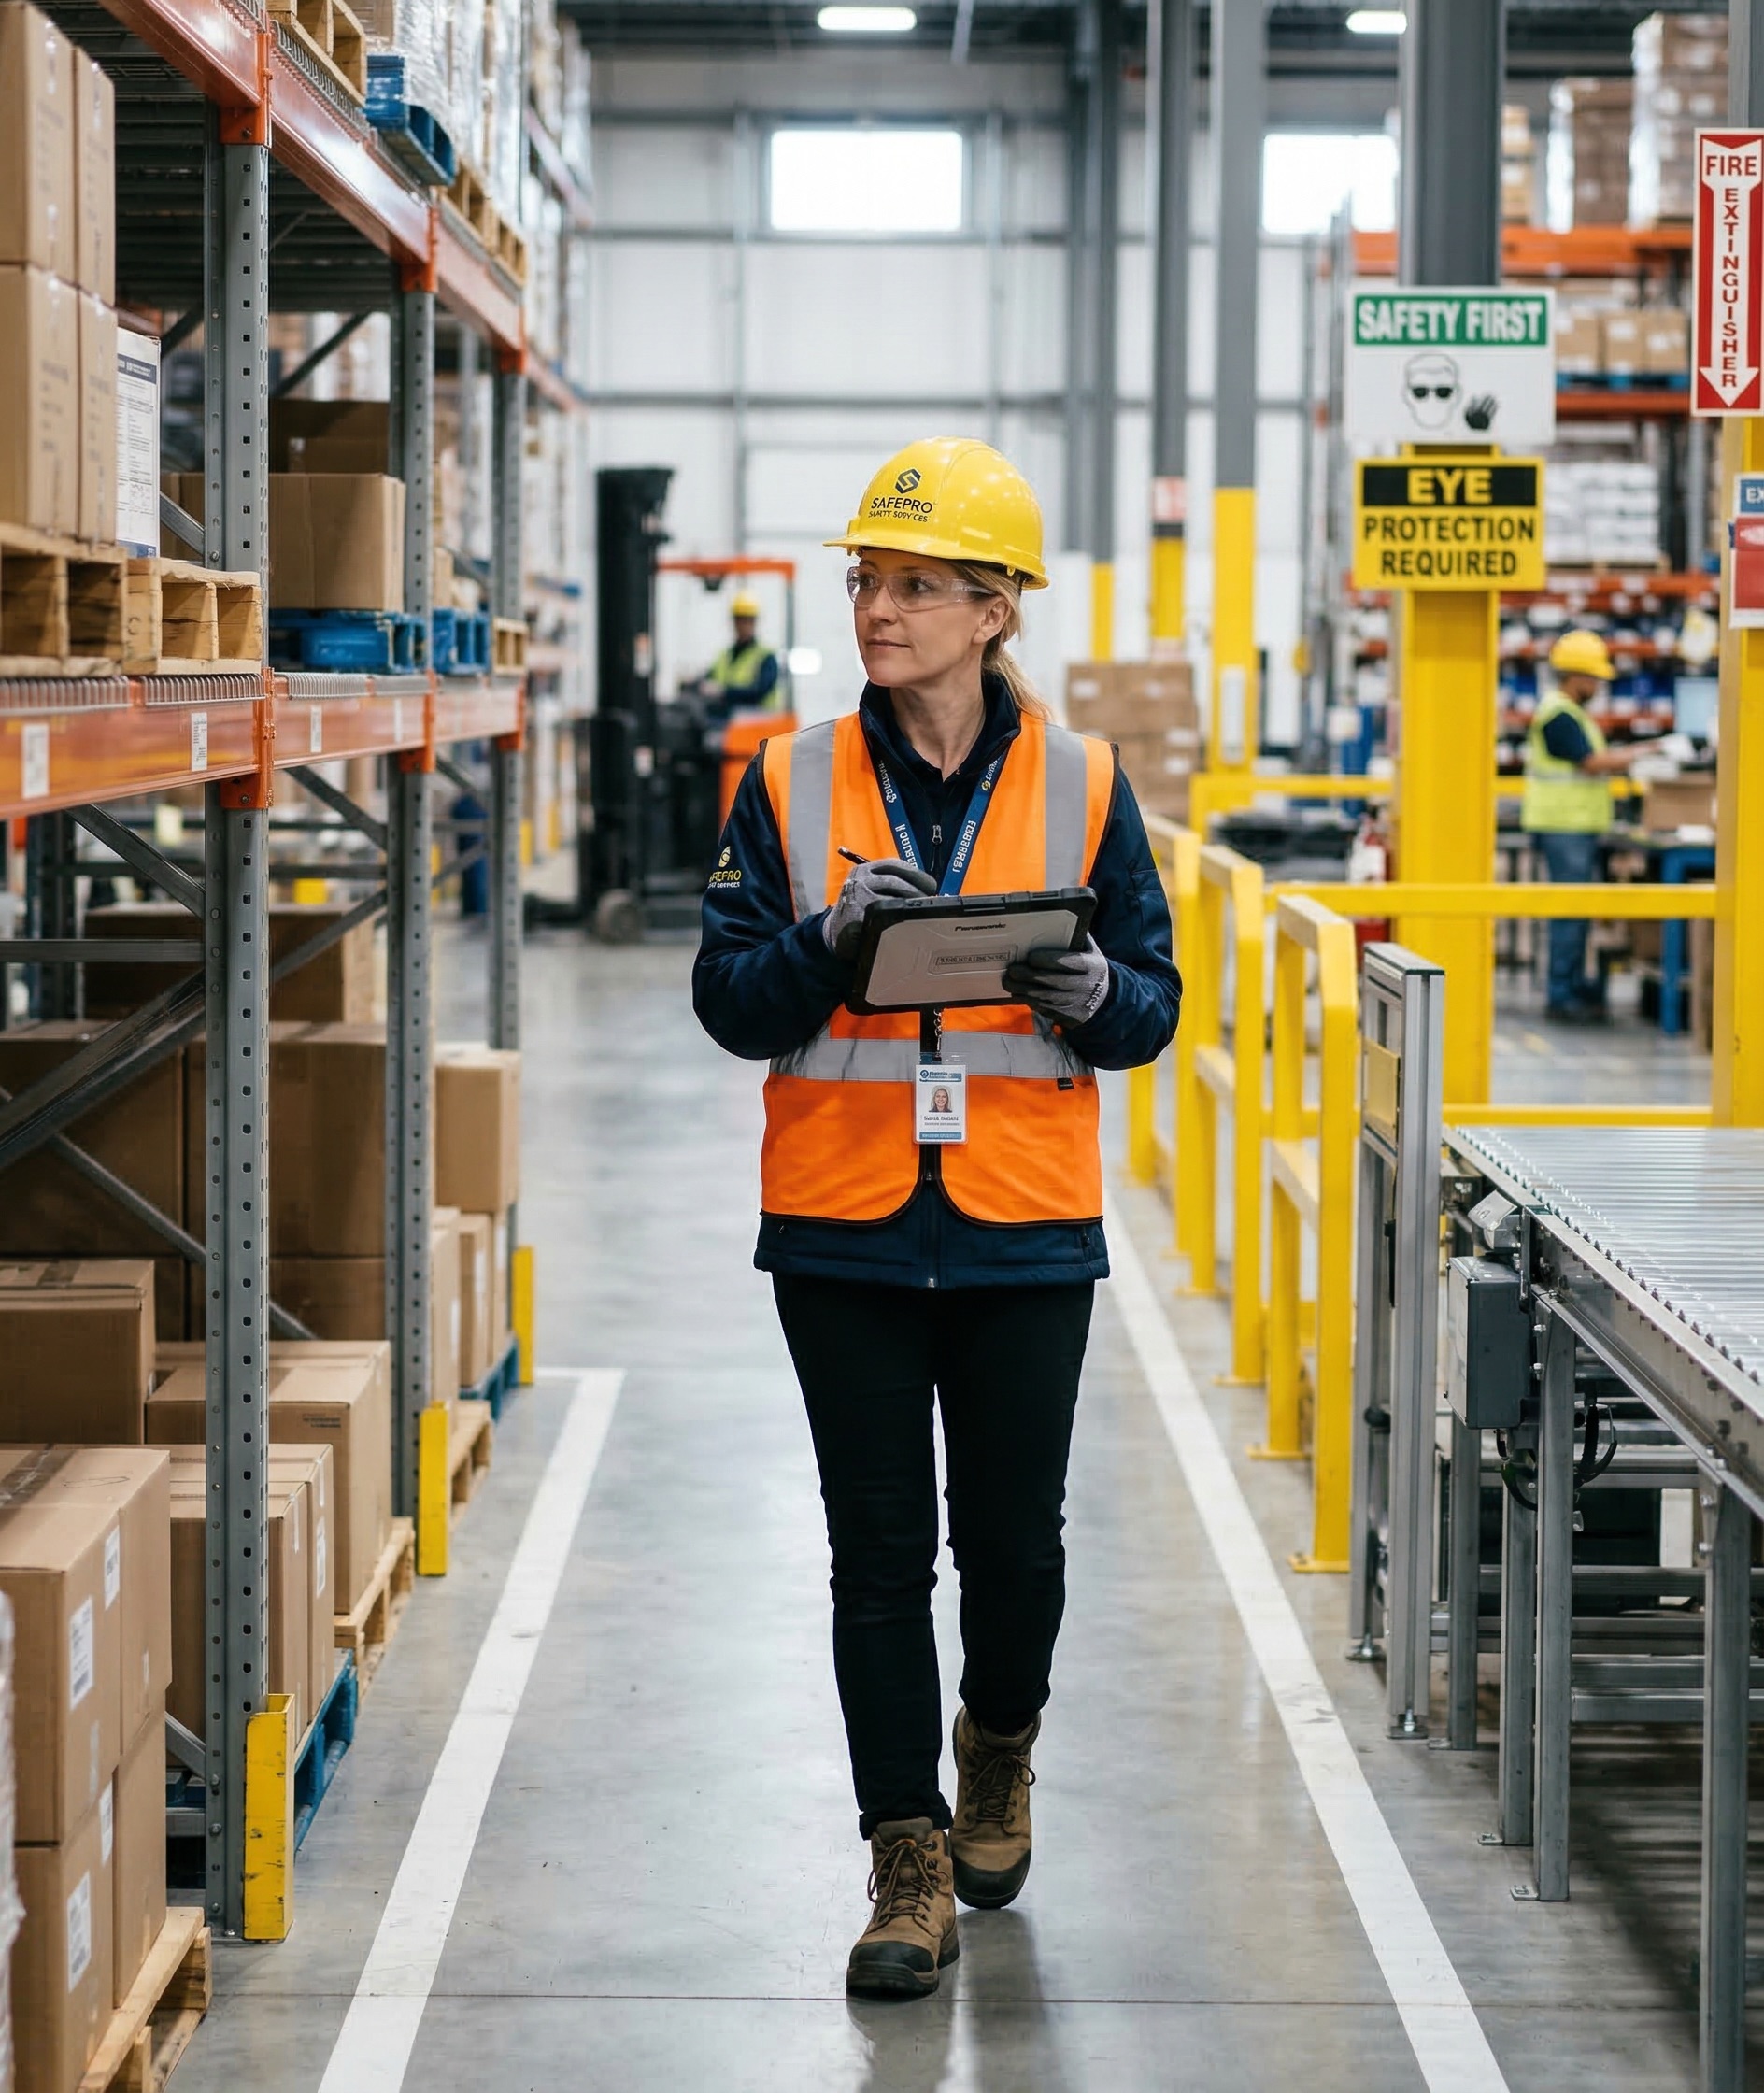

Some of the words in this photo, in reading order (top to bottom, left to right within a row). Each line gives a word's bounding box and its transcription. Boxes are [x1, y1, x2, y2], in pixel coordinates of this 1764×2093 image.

[1706, 155, 1757, 176] FIRE
[1722, 188, 1739, 387] EXTINGUISHER
[1359, 299, 1461, 341] SAFETY
[1466, 300, 1543, 342] FIRST
[1407, 468, 1493, 505] EYE
[871, 497, 933, 514] SAFEPRO
[1364, 517, 1535, 542] PROTECTION
[1381, 550, 1517, 577] REQUIRED
